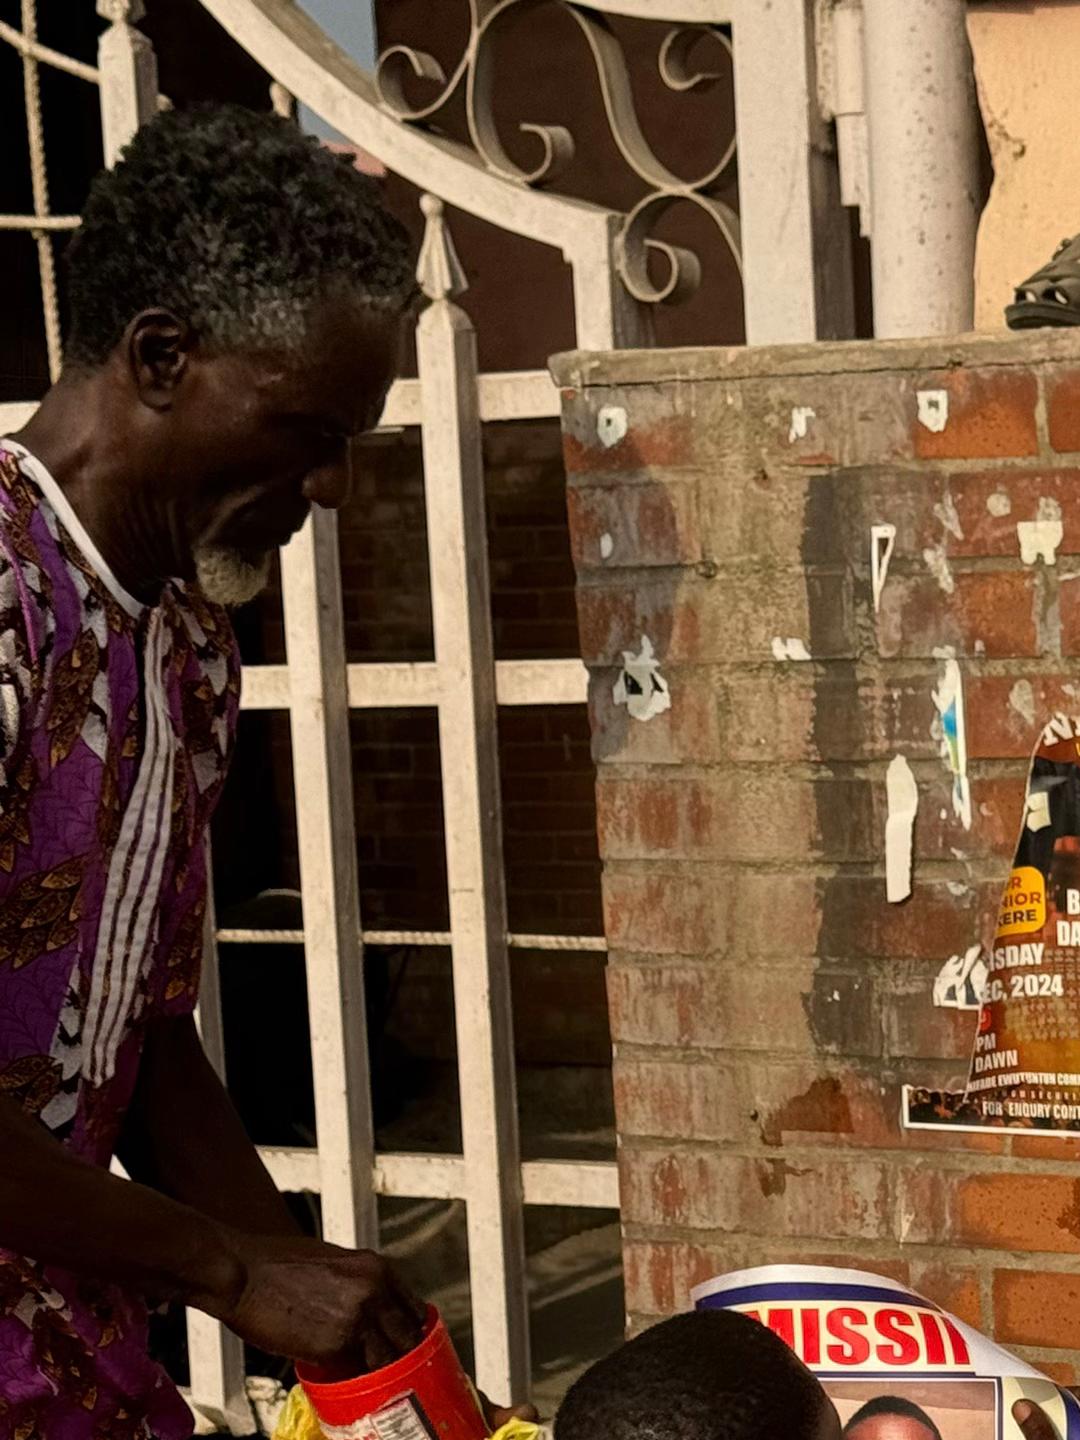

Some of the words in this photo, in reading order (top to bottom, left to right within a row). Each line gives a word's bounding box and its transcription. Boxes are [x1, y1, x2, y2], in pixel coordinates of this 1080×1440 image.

[1010, 974, 1064, 997] 2024
[975, 1050, 1018, 1073] DAWN
[982, 1102, 1003, 1116] FOR
